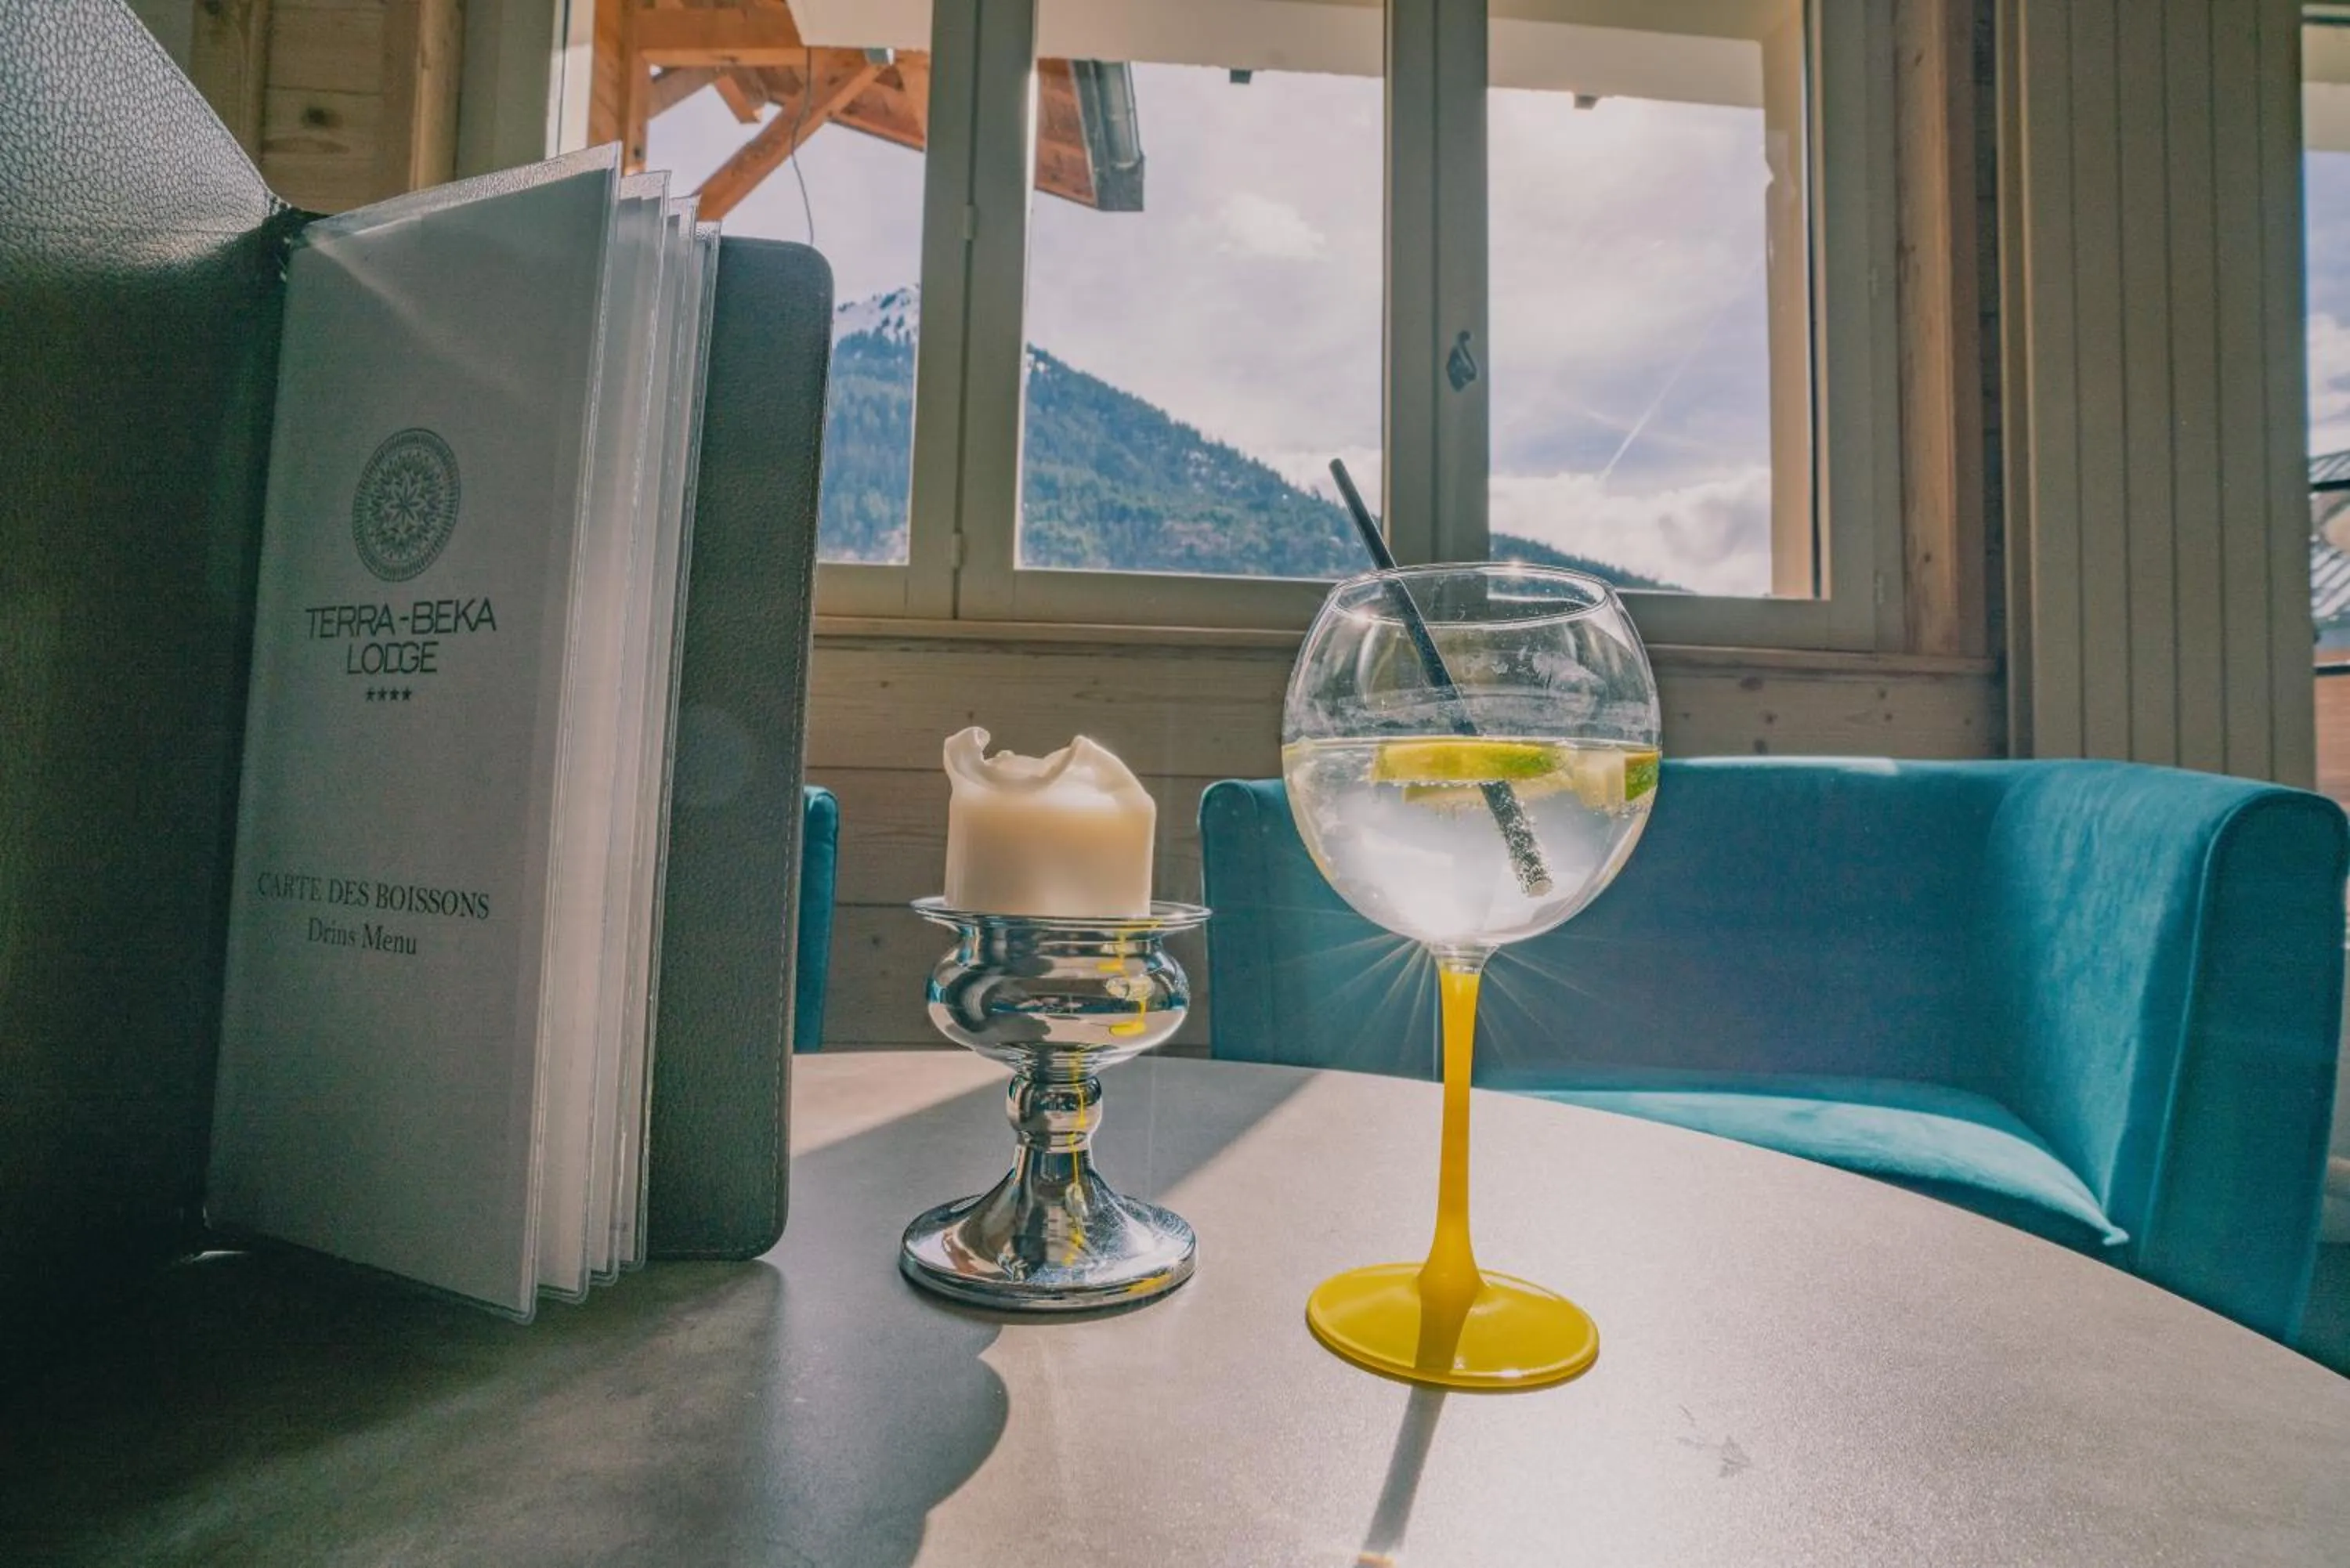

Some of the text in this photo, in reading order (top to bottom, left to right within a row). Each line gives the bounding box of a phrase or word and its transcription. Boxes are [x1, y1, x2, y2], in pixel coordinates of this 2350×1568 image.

[306, 597, 497, 638] TERRA-BEKA
[347, 641, 439, 674] LODGE
[258, 872, 490, 919] CARTE DES BOISSONS
[308, 917, 417, 955] Drins Menu
